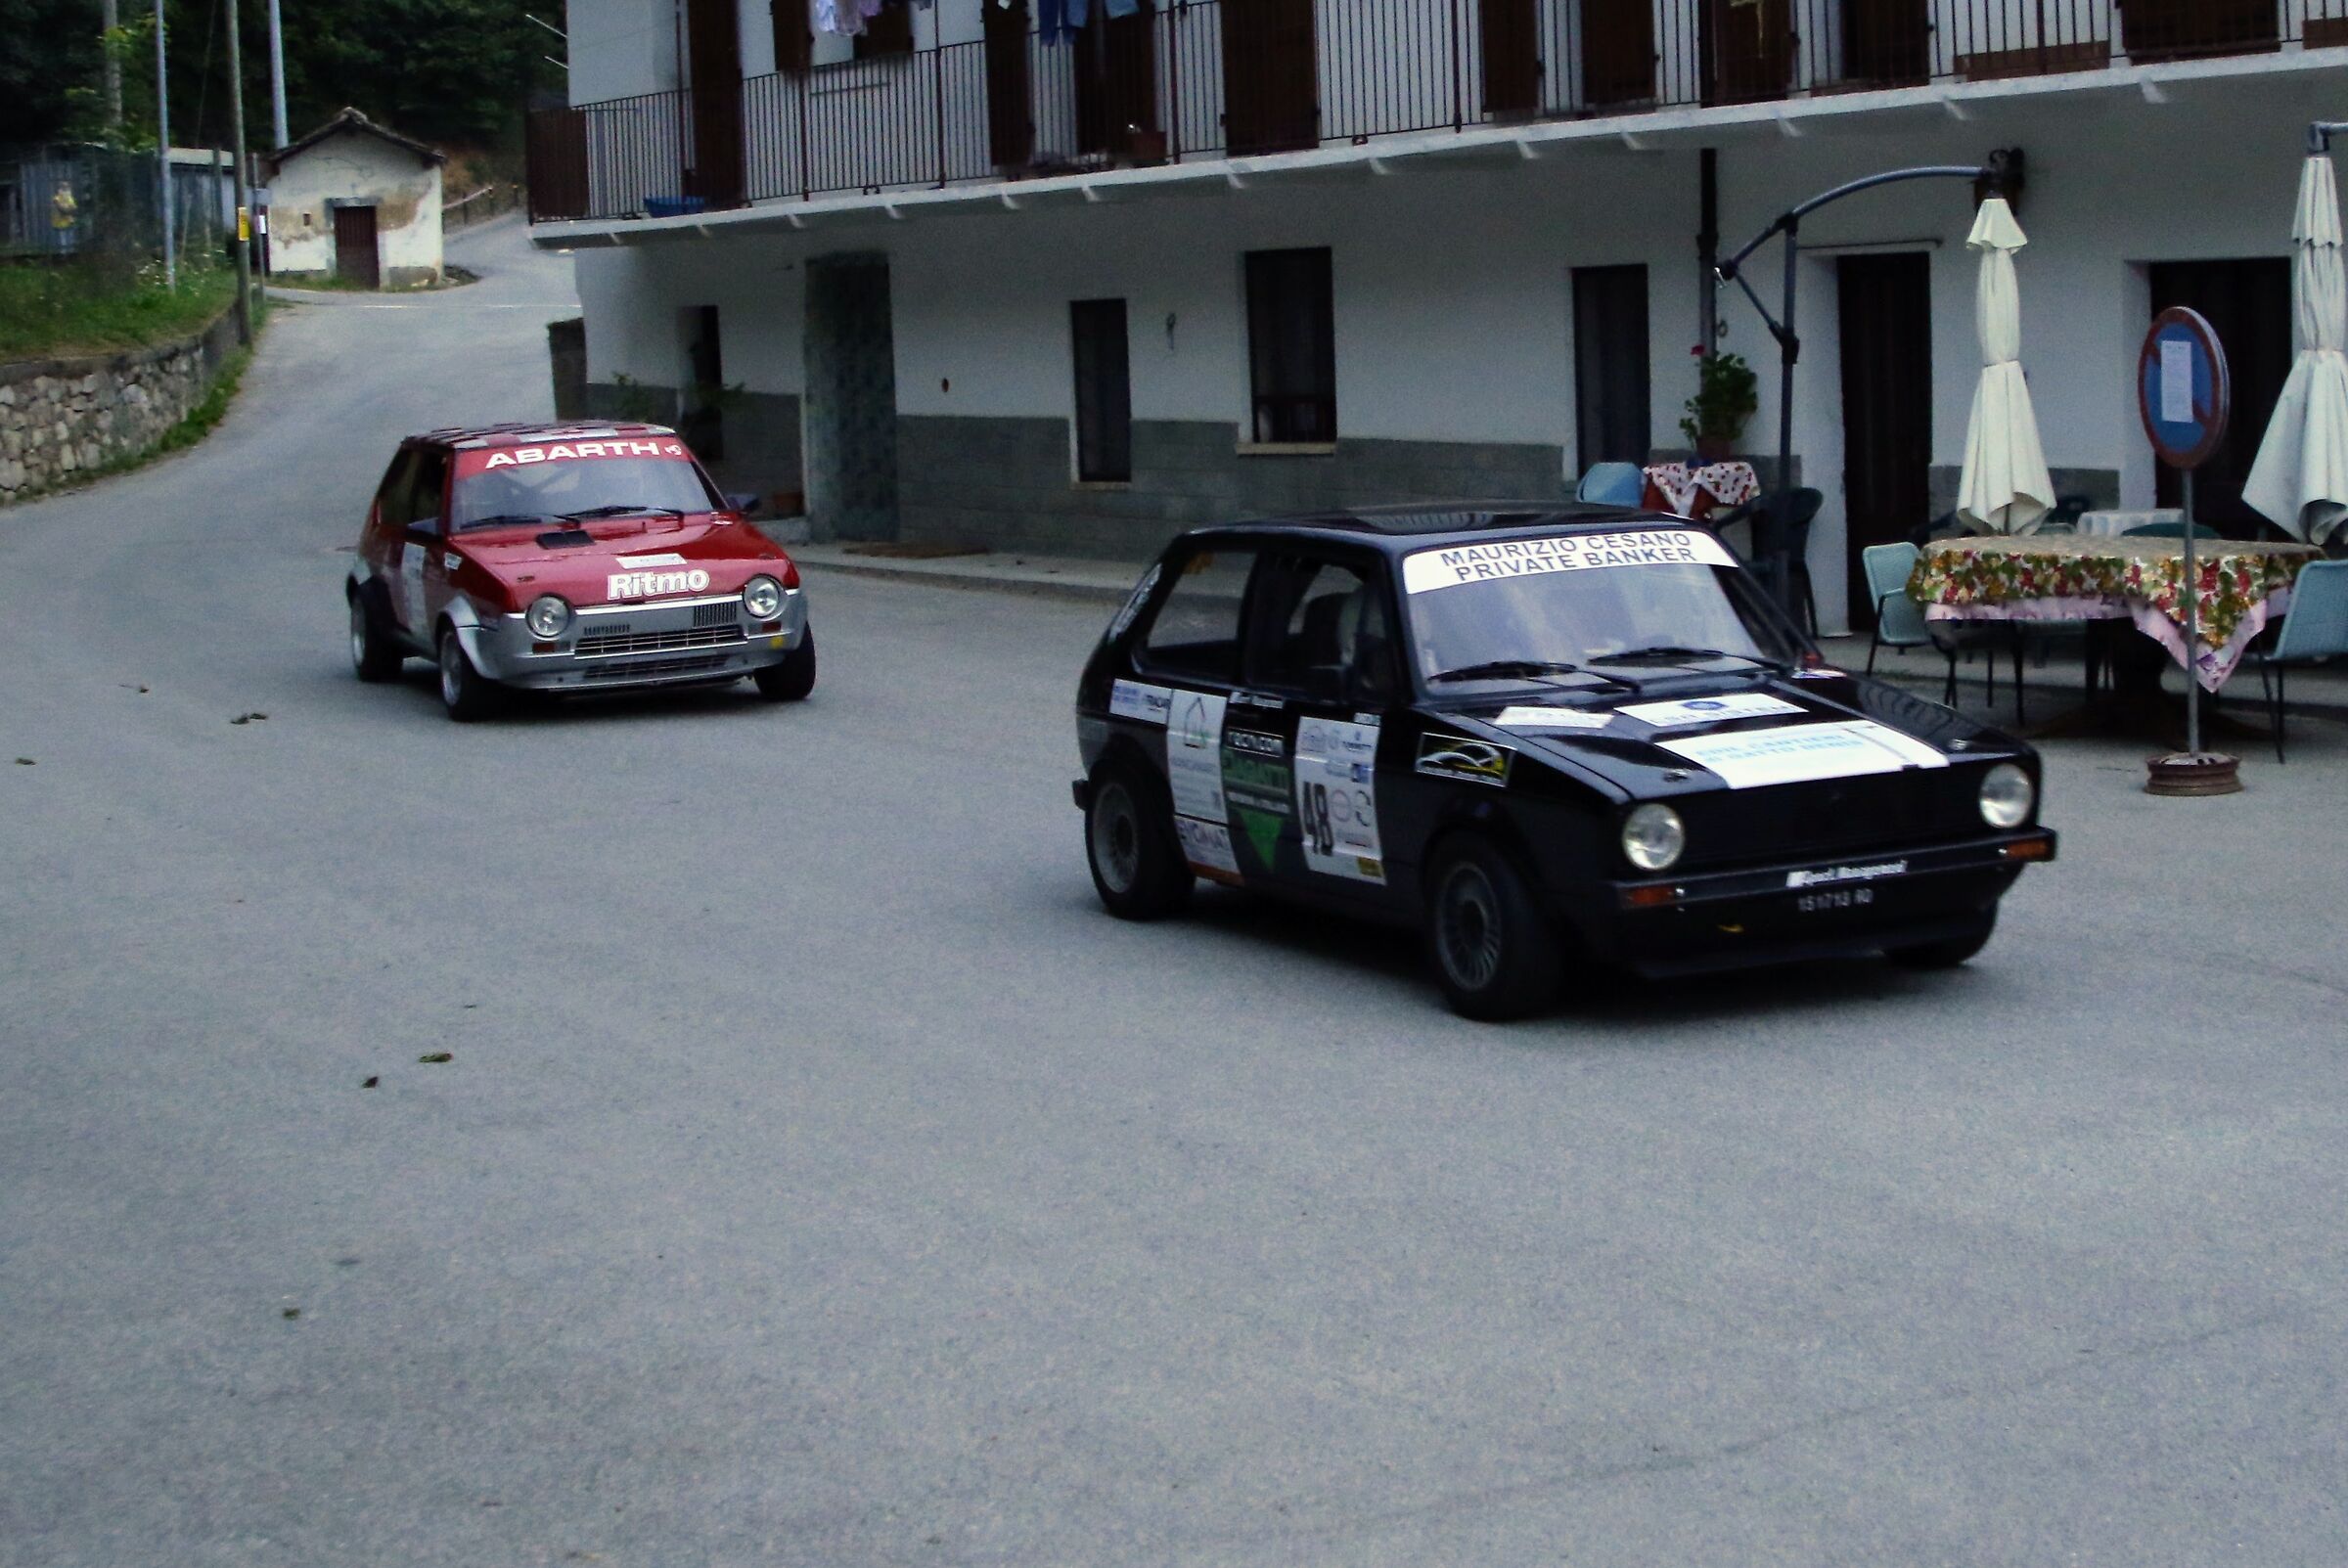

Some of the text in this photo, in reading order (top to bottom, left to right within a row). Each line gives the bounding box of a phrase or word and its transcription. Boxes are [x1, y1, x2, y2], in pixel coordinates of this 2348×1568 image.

[485, 442, 660, 470] ABARTH
[1440, 532, 1691, 566] MAURIZIO CESANO
[1455, 548, 1697, 581] PRIVATE BANKER
[607, 569, 710, 601] Ritmo
